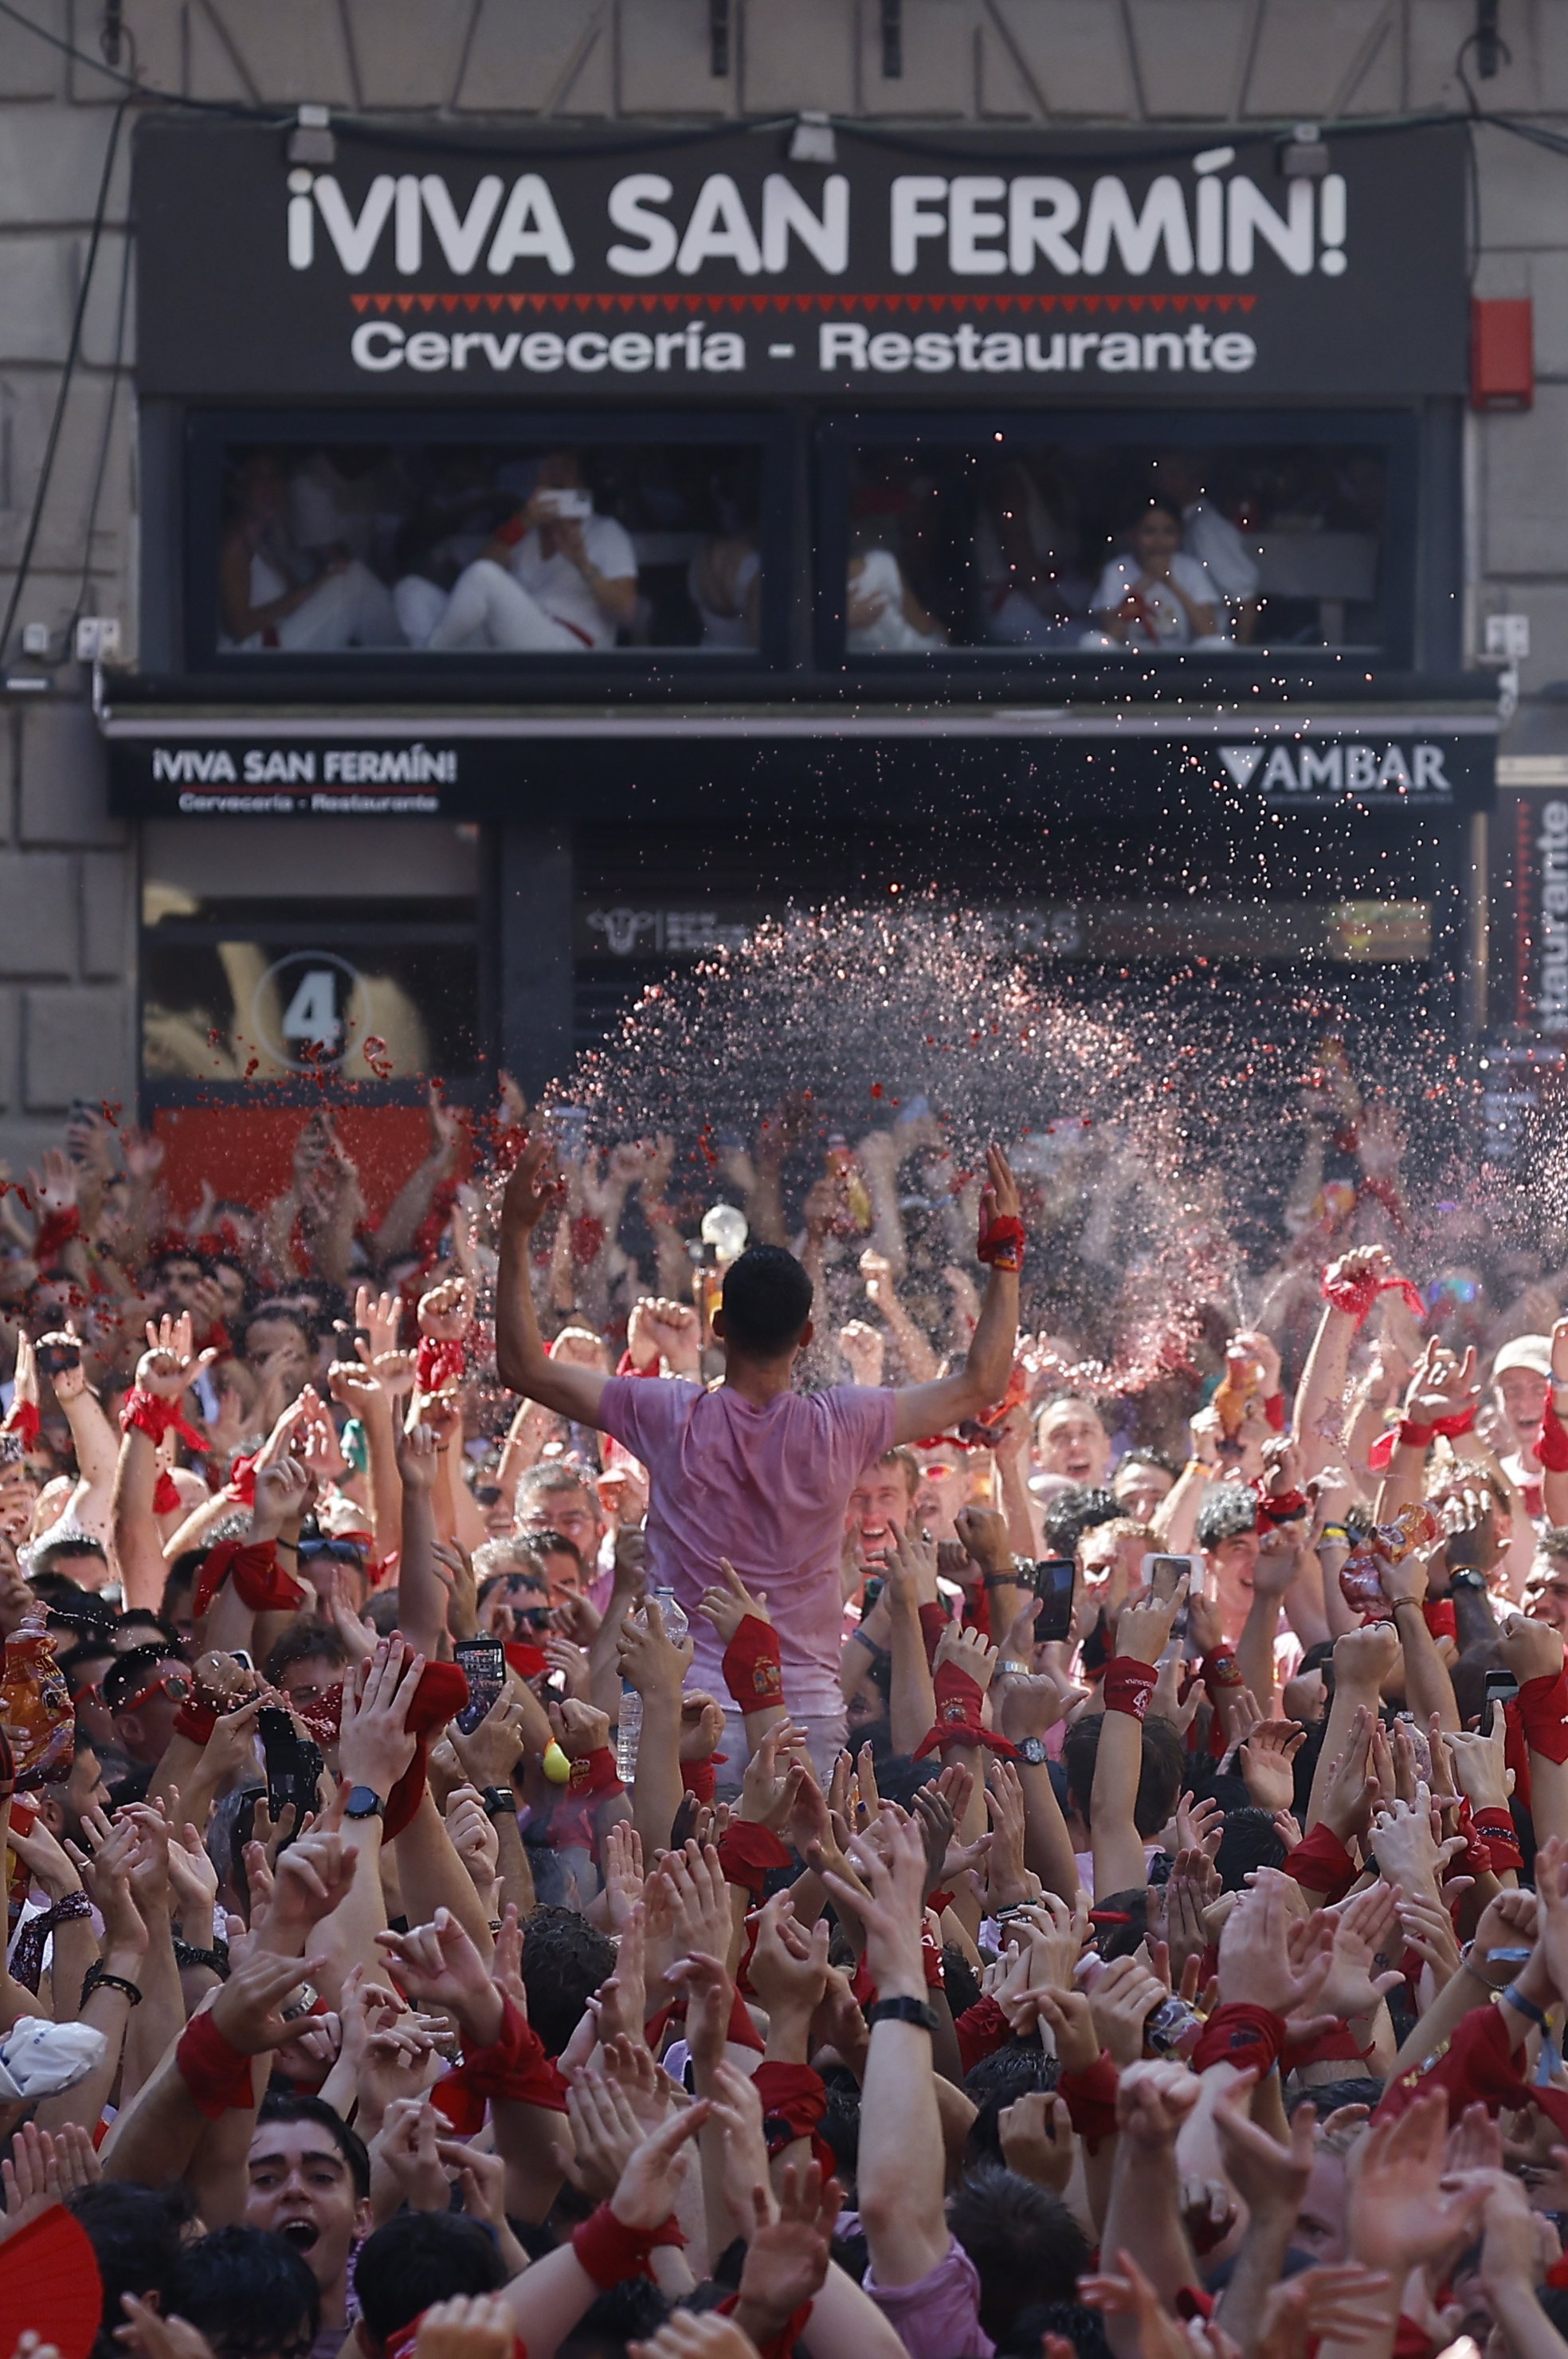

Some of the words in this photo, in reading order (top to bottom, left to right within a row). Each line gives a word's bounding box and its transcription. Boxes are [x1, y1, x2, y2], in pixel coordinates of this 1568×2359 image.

[288, 168, 575, 275] ¡VIVA
[606, 174, 850, 277] SAN
[891, 147, 1348, 276] FERMÍN!
[351, 320, 746, 372] Cervecería
[819, 322, 1257, 372] Restaurante
[243, 750, 316, 783] SAN
[1260, 745, 1452, 791] AMBAR
[282, 971, 341, 1052] 4
